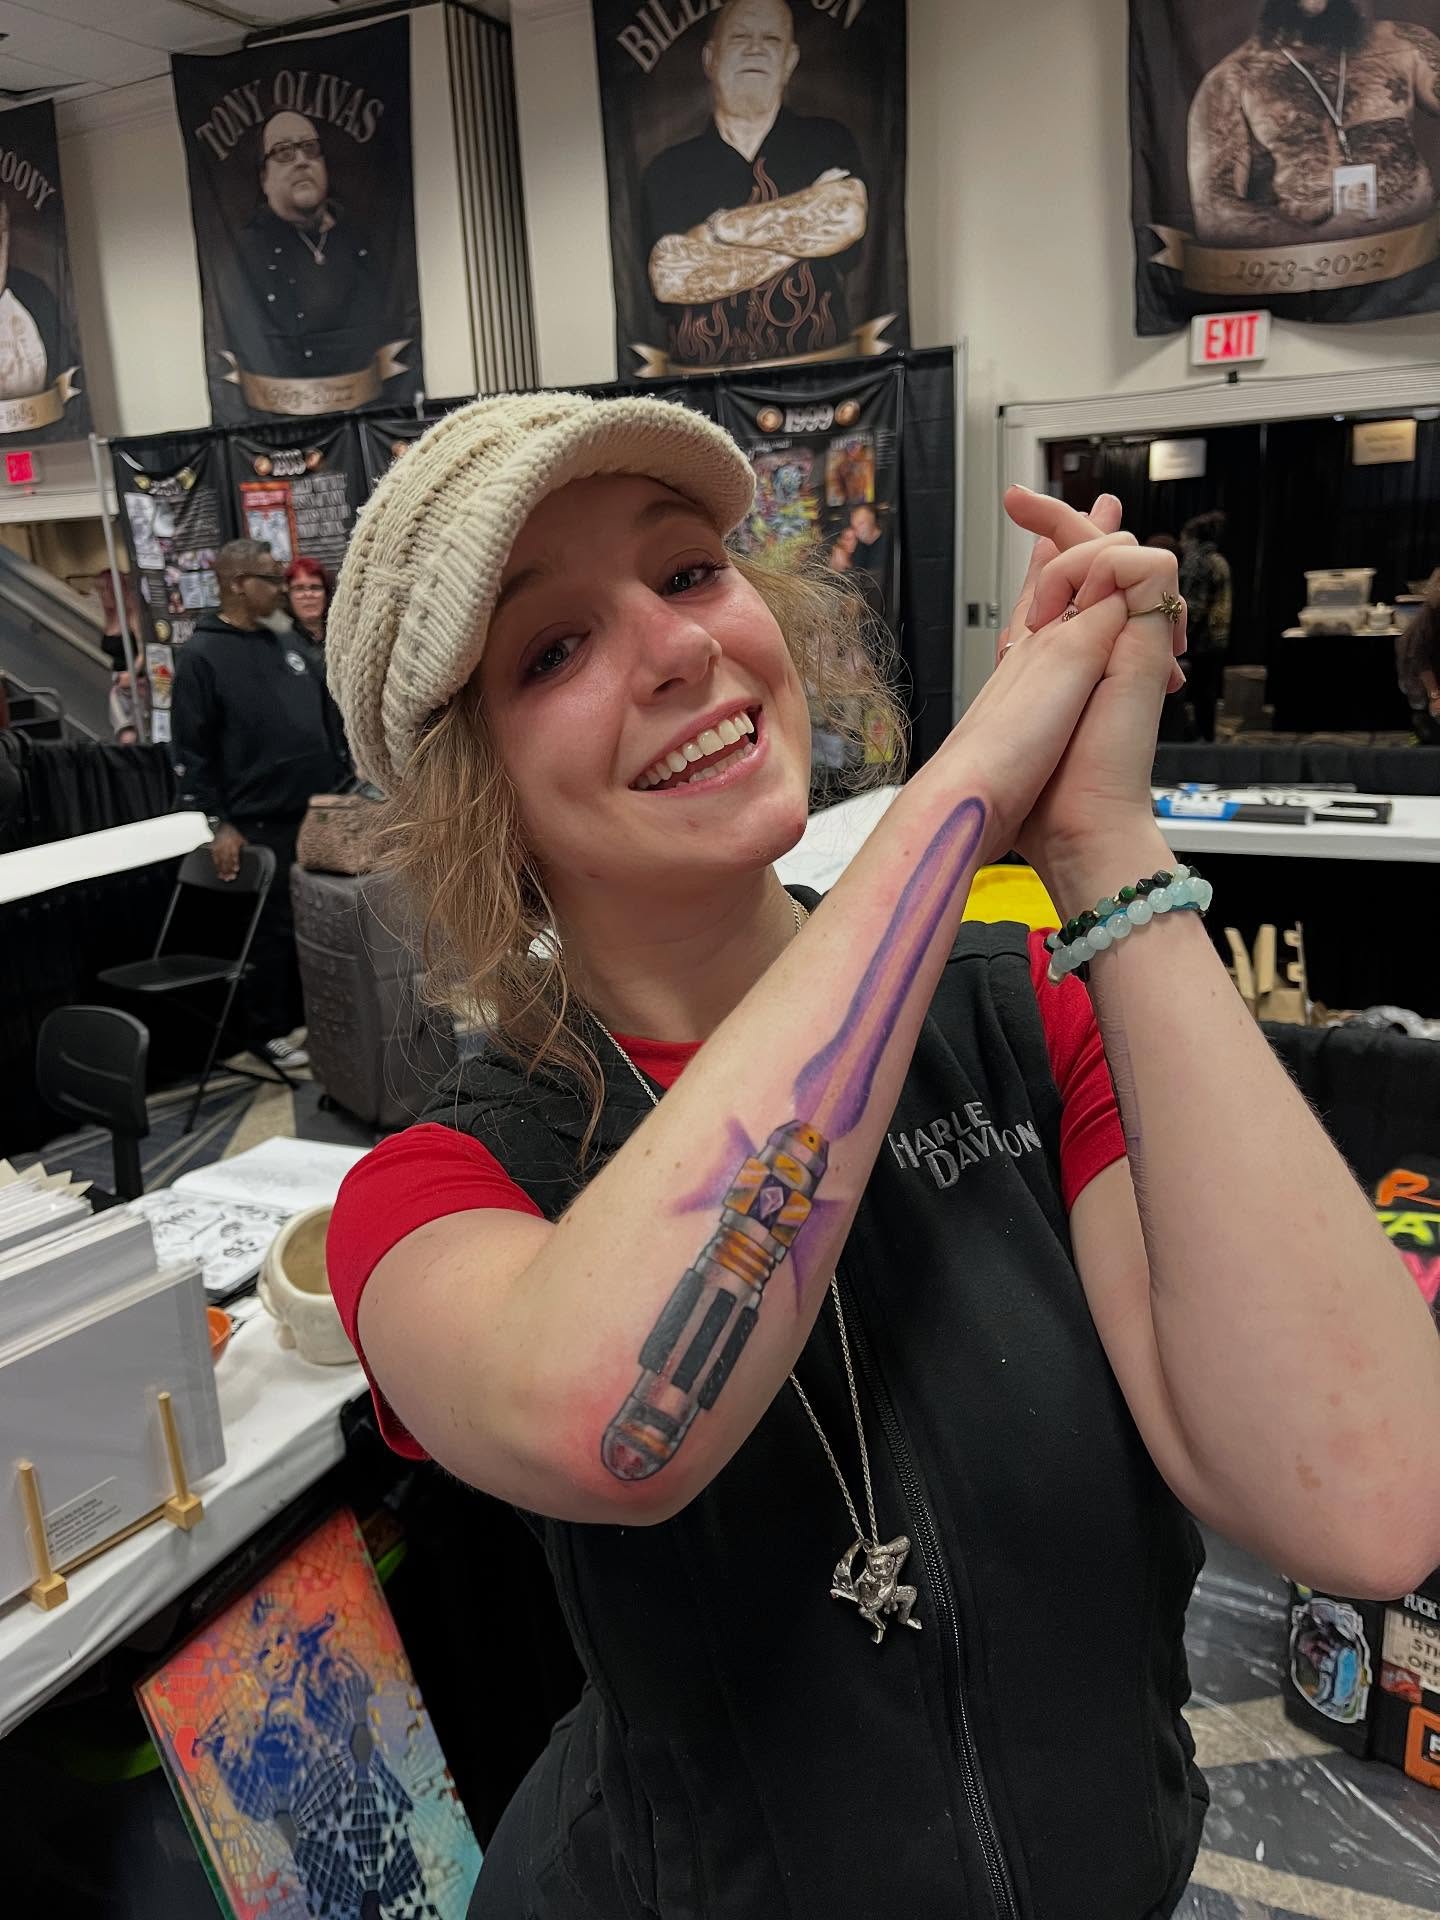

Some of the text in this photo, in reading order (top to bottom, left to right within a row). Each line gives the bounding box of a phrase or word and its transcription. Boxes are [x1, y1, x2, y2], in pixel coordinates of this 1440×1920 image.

[617, 0, 726, 73] BILL
[195, 70, 385, 161] TONY OLIVAS
[0, 147, 56, 211] OOVY
[1234, 247, 1386, 288] 1973-2022
[1203, 313, 1260, 361] EXIT
[887, 1101, 992, 1169] HARLE
